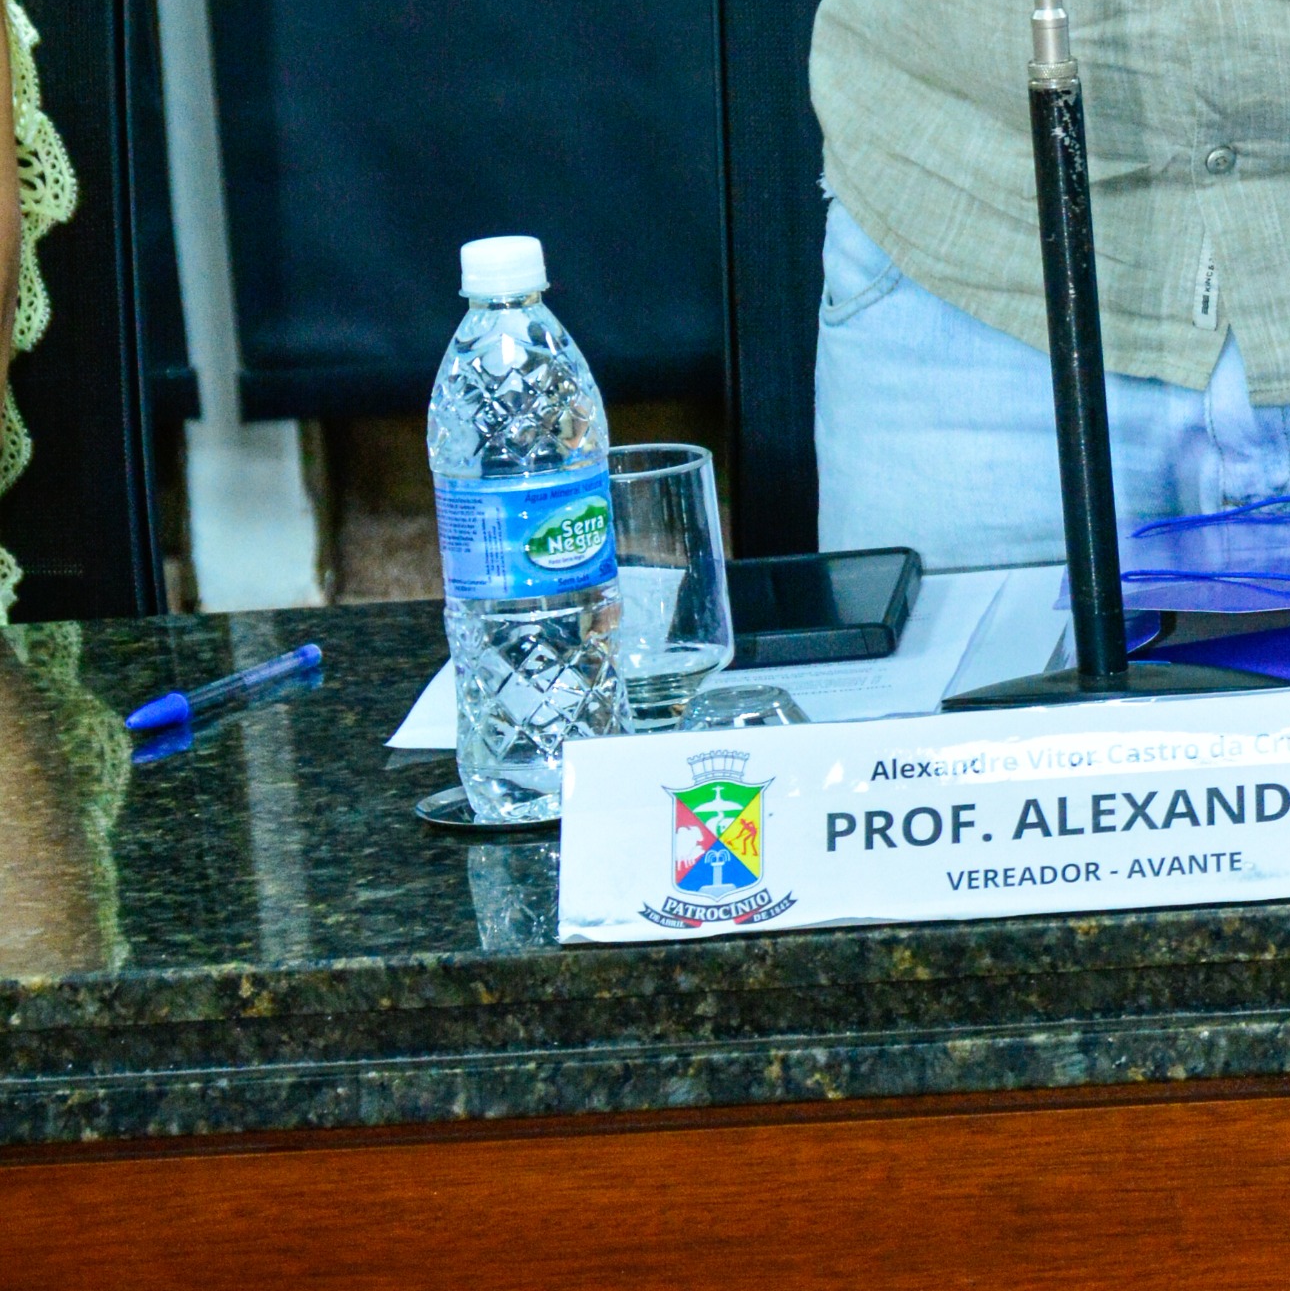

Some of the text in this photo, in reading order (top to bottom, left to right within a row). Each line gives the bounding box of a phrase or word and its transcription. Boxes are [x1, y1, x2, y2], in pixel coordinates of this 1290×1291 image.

[561, 514, 605, 538] Serra
[547, 530, 602, 554] Negra
[871, 751, 1019, 781] Alexandre
[1027, 748, 1097, 771] Vitor
[1107, 742, 1199, 764] Castro
[1209, 735, 1243, 758] da
[826, 801, 993, 853] PROF.
[947, 861, 1101, 891] VEREADOR
[1127, 851, 1243, 880] AVANTE
[663, 891, 769, 921] PATROCÍNIO
[753, 912, 768, 922] DE
[660, 915, 686, 928] ABRIL
